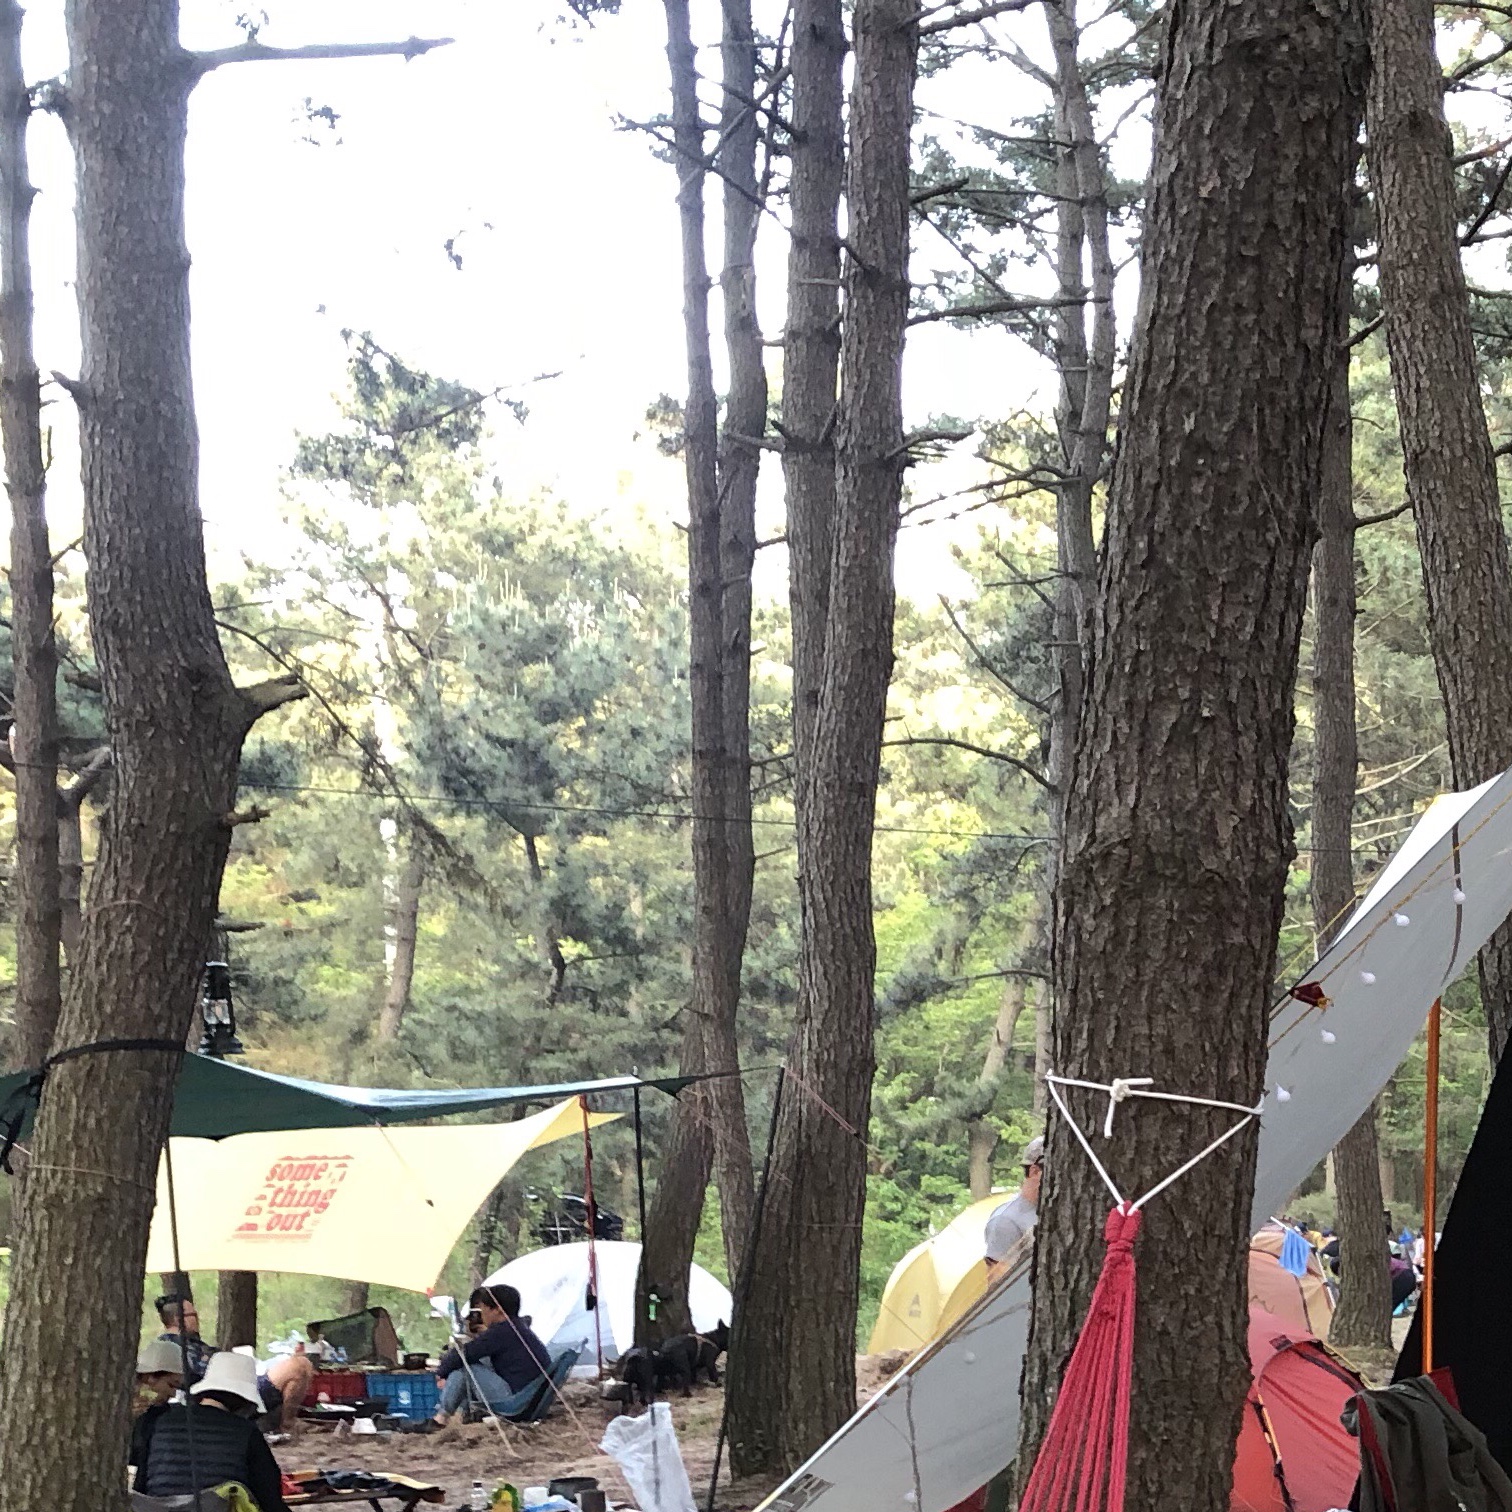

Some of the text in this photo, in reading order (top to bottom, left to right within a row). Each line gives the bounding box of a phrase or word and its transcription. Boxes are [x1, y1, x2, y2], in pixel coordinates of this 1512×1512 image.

[265, 1162, 329, 1182] some
[267, 1182, 338, 1214] thing
[265, 1210, 311, 1232] out
